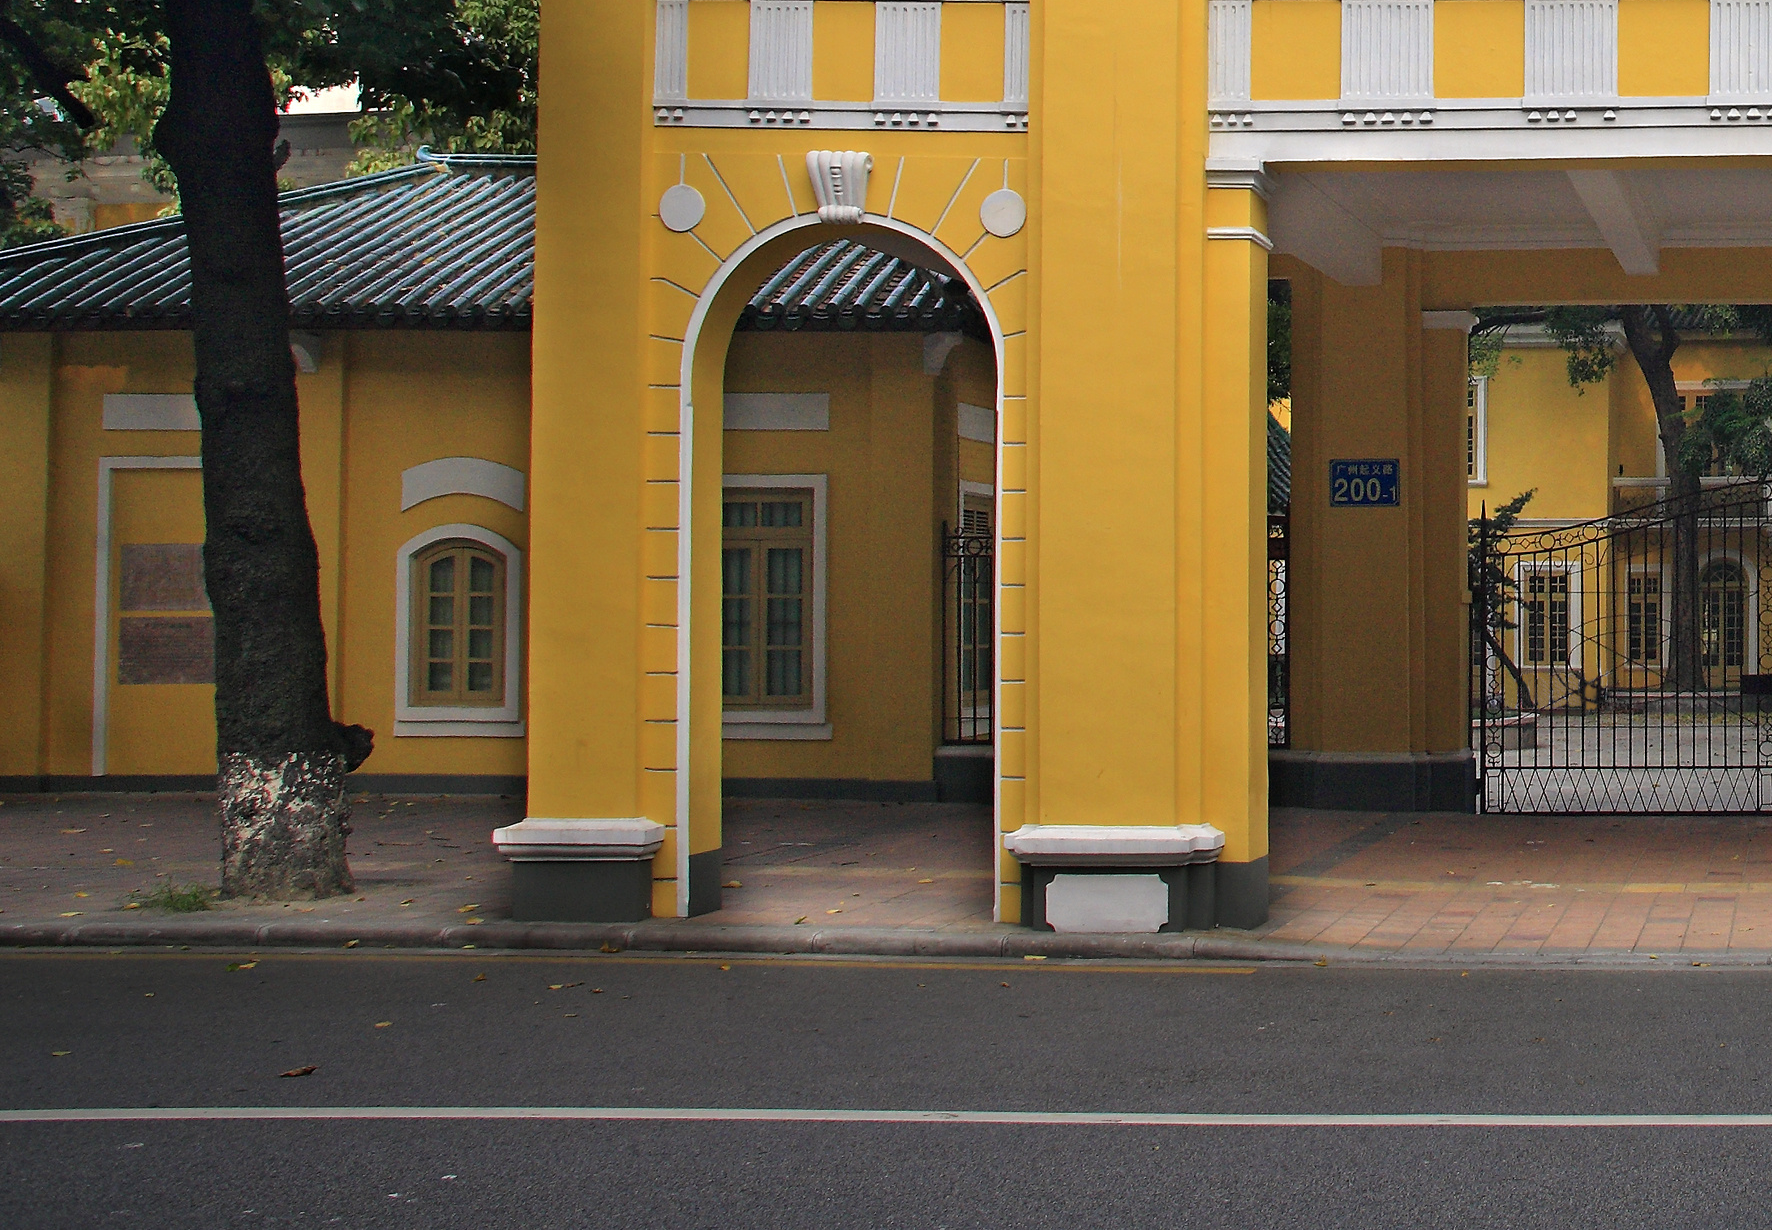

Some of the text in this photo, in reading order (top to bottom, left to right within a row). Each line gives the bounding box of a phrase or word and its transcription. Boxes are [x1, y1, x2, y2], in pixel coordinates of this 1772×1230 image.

[1336, 464, 1393, 476] 广州起义路
